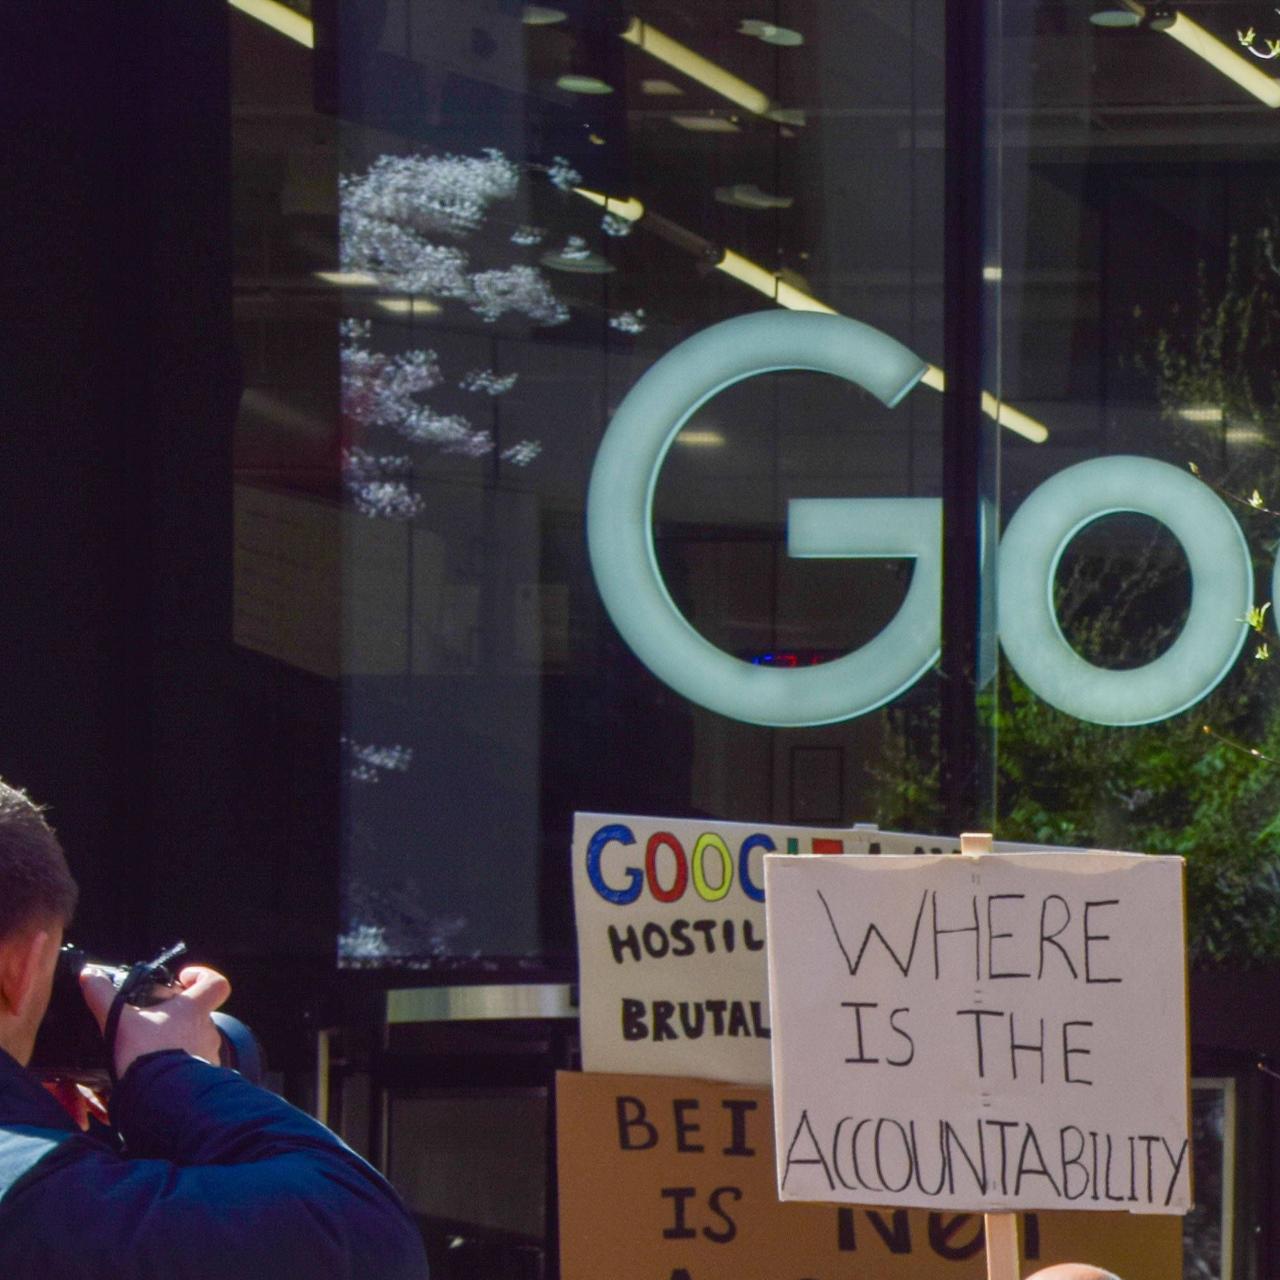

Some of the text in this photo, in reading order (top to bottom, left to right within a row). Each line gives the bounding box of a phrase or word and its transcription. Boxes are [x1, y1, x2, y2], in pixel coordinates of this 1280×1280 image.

[586, 823, 843, 905] GOOG
[608, 918, 765, 964] HOSTIL
[818, 889, 1121, 983] WHERE
[841, 1002, 1094, 1085] IS THE
[615, 1096, 758, 1158] BEI
[782, 1110, 1189, 1206] ACCOUNTABILITY
[661, 1186, 743, 1243] IS
